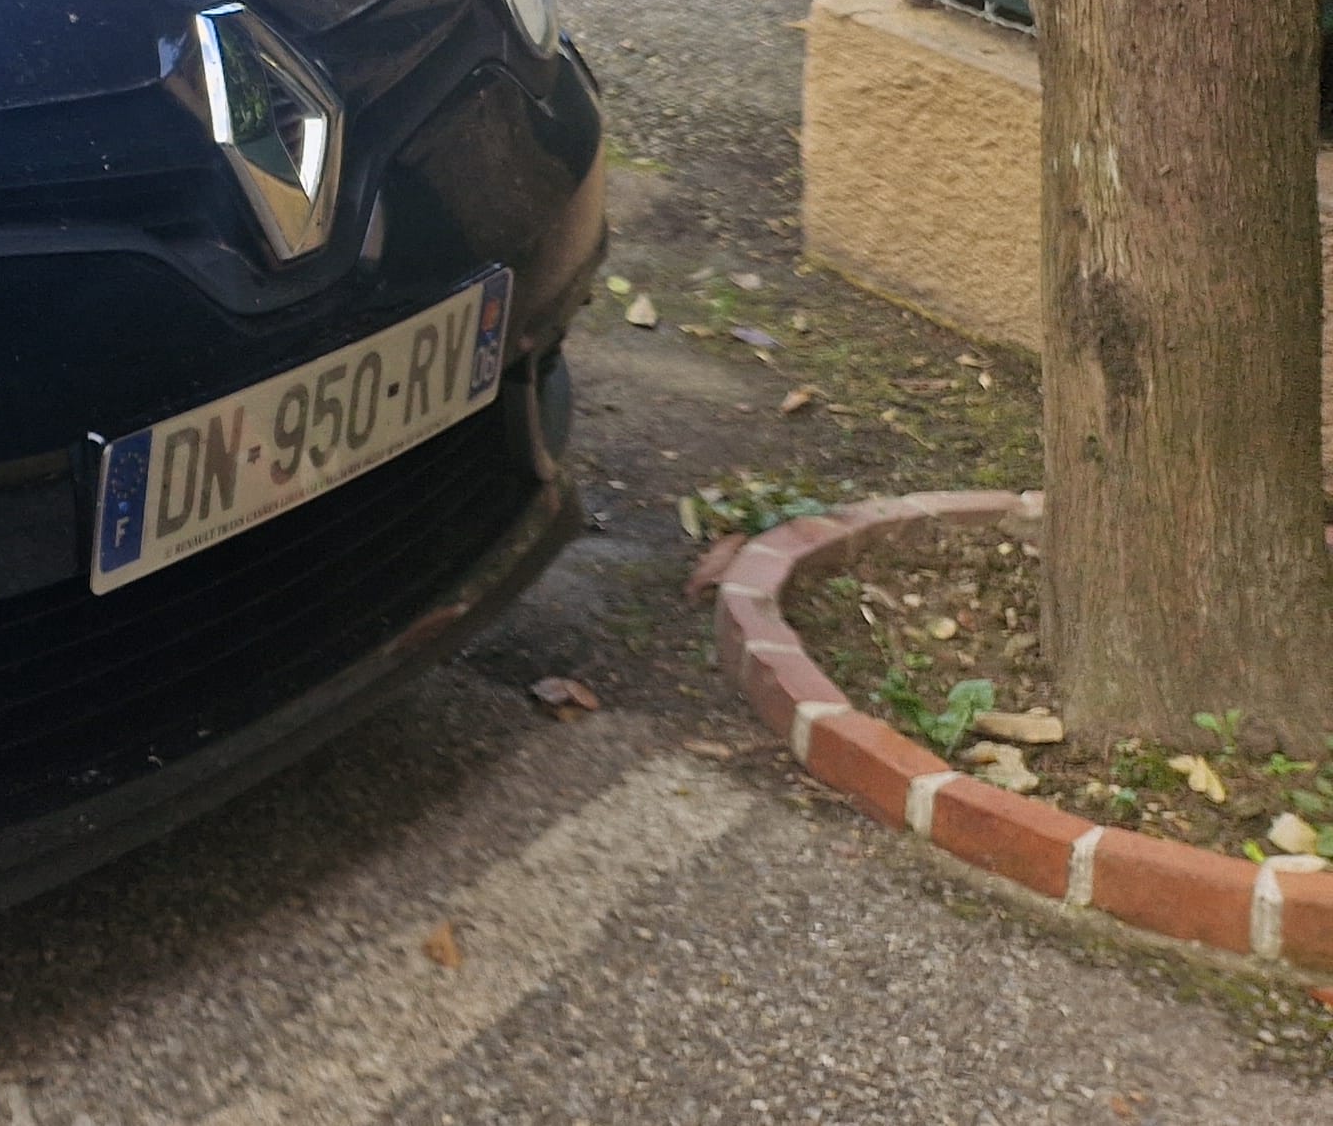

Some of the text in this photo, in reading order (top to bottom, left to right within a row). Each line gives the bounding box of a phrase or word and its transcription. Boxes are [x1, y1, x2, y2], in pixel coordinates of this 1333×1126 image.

[471, 340, 497, 388] 06
[156, 302, 472, 540] DN-950-RV
[115, 516, 130, 548] F
